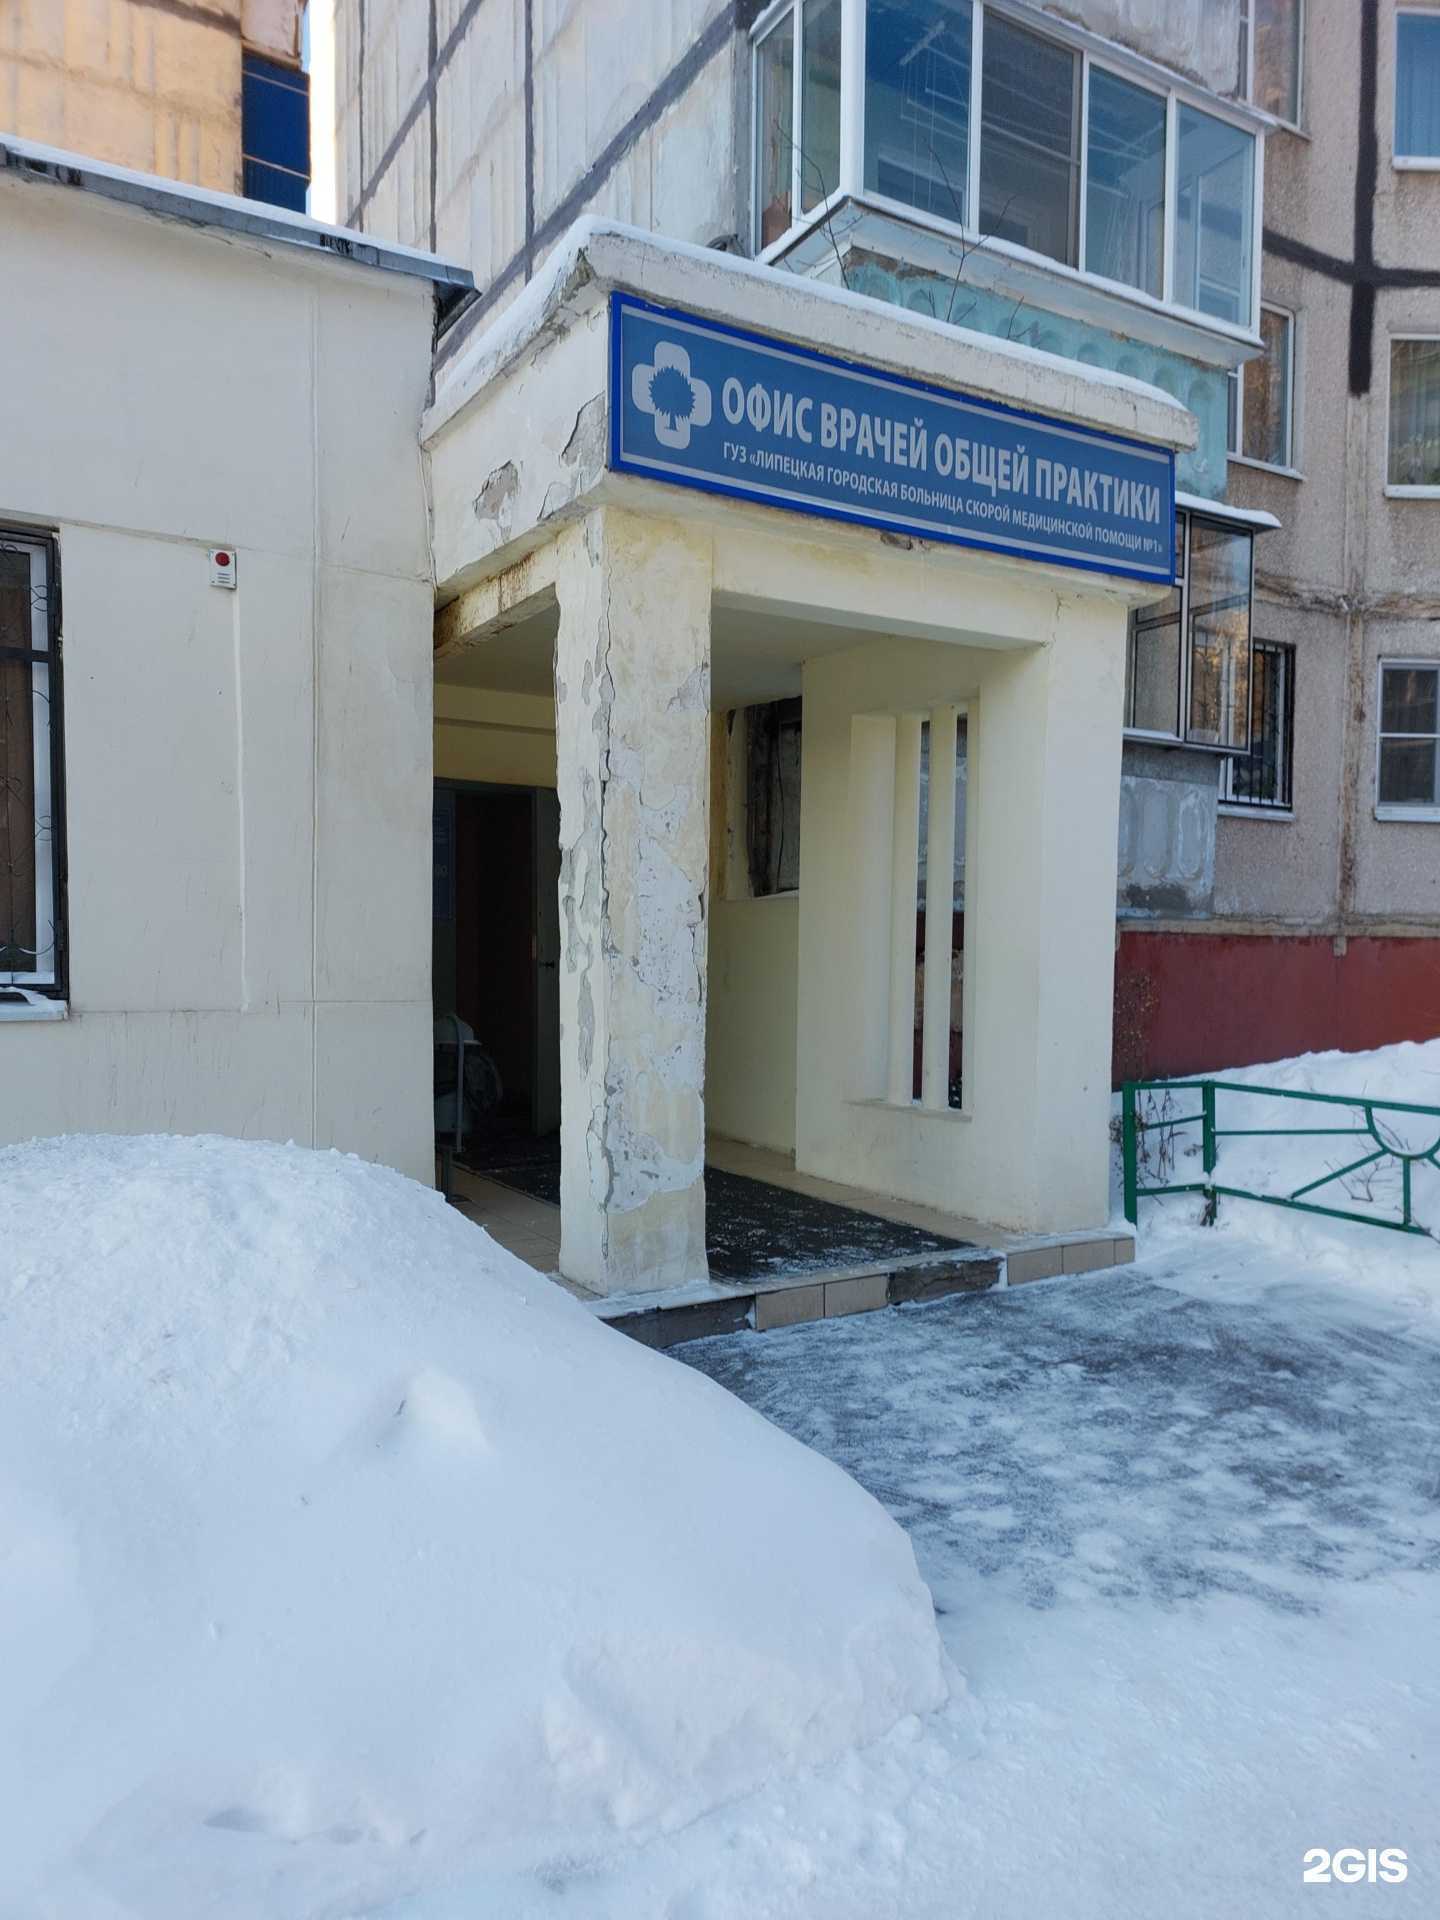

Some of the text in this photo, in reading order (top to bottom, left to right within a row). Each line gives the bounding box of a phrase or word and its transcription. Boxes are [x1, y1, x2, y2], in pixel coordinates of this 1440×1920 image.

[722, 377, 1161, 525] ОФИС ВРАЧЕЙ ОБЩЕЙ ПРАКТИКИ
[723, 441, 747, 464] ГУЗ
[749, 449, 824, 482] «ЛИПЕЦКАЯ
[827, 466, 898, 499] ГОРОДСКАЯ
[900, 483, 964, 515] БОЛЬНИЦА
[965, 498, 1010, 524] СКОРОЙ
[1012, 509, 1093, 539] МЕДИЦИНСКОЙ
[1094, 526, 1144, 553] ПОМОЩИ
